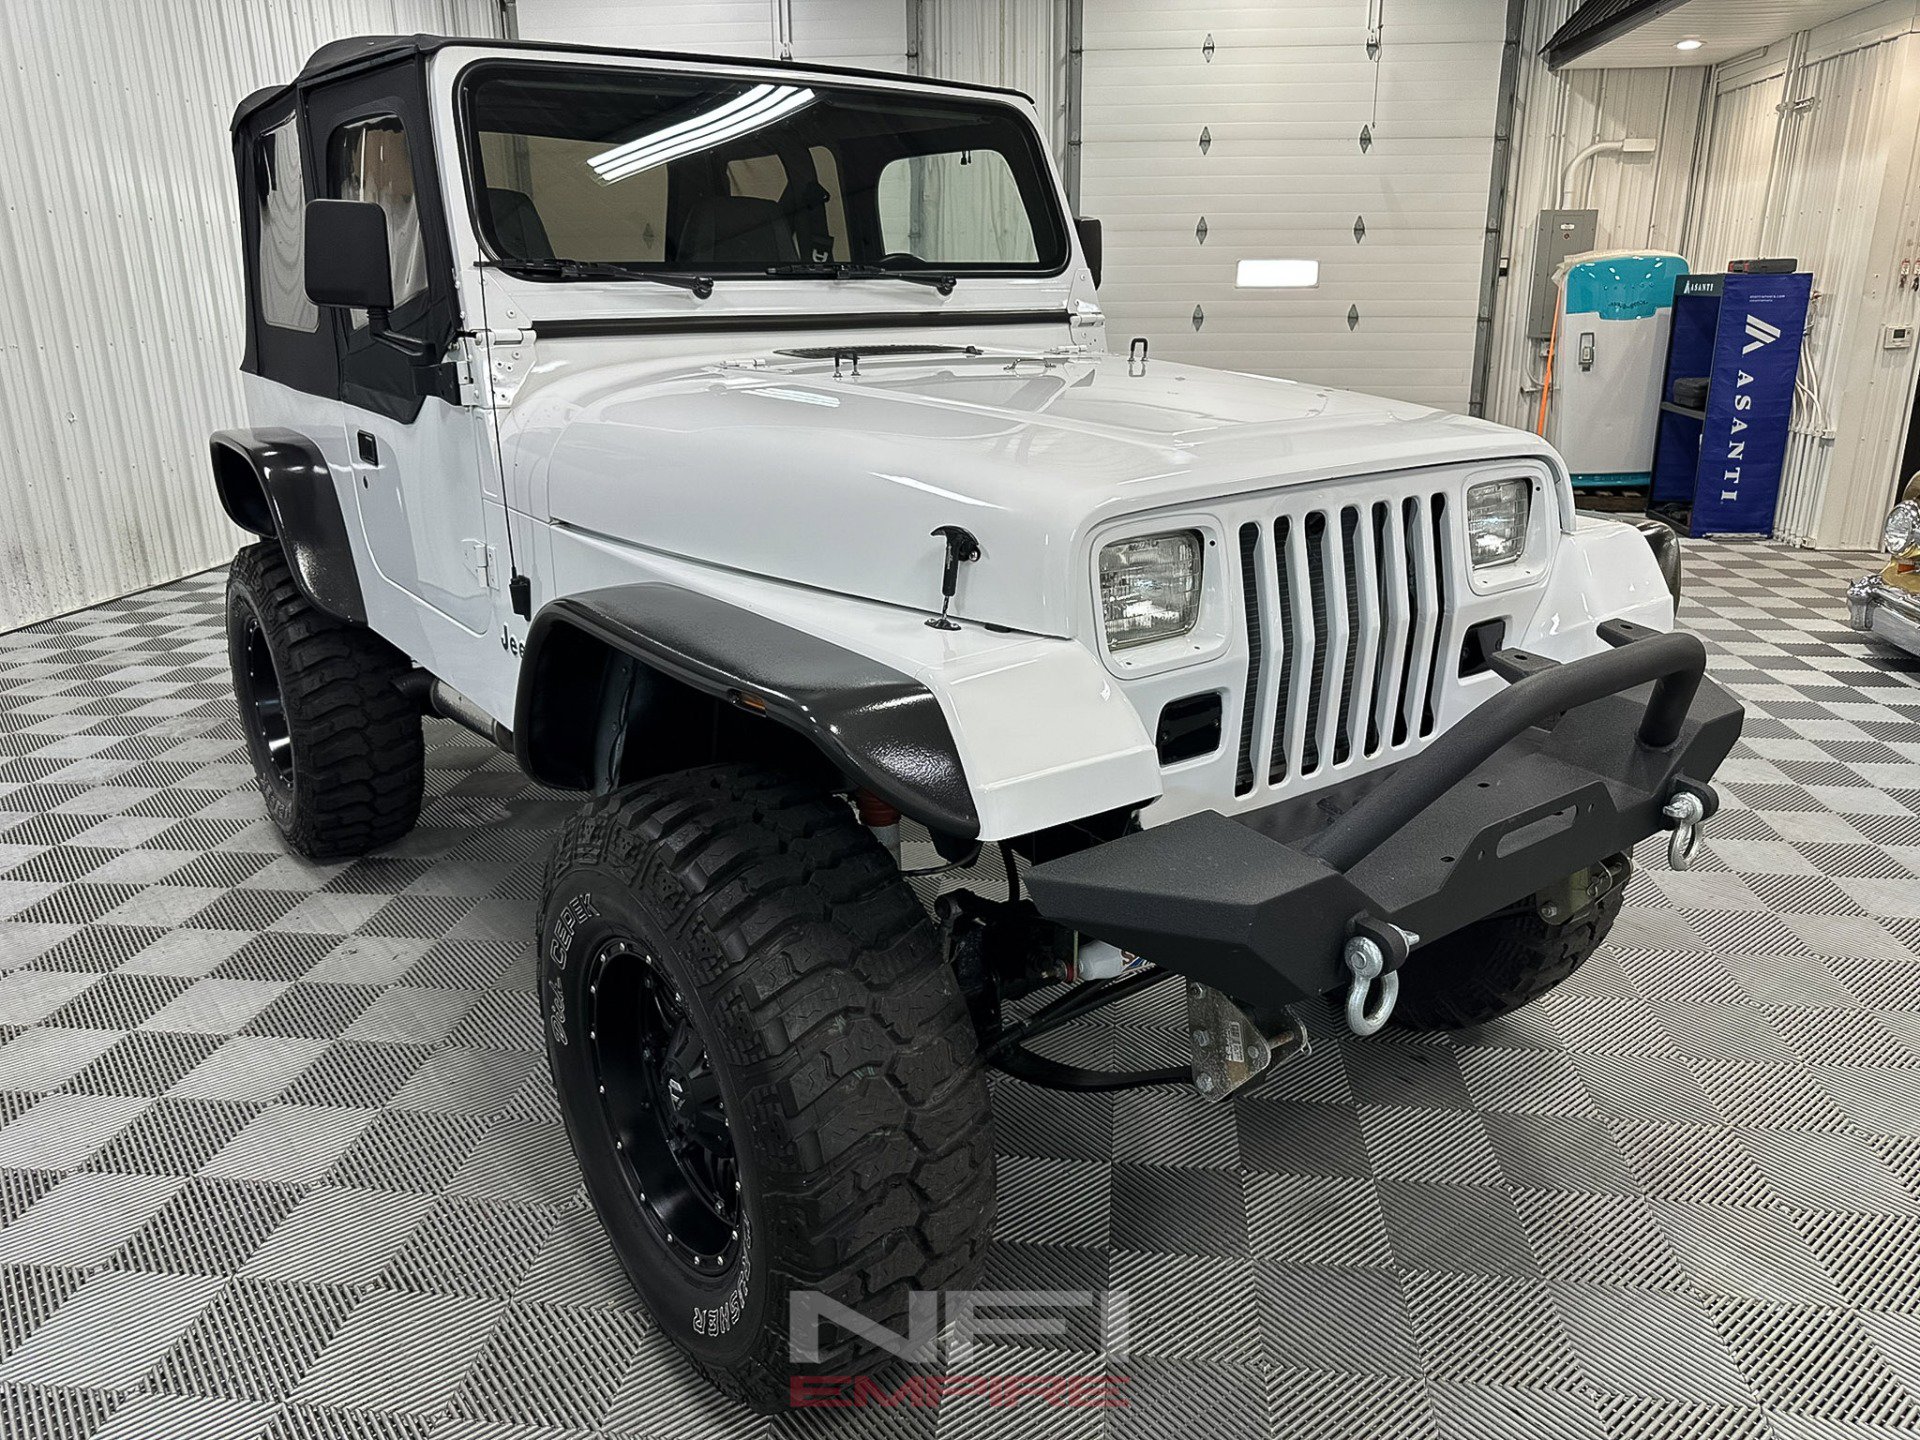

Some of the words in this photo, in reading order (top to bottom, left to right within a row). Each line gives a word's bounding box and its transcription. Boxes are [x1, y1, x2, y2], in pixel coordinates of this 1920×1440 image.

[1690, 283, 1714, 292] ASANTI
[1721, 369, 1754, 501] ASANTI
[501, 624, 526, 659] Jee
[550, 893, 601, 970] CEPEK
